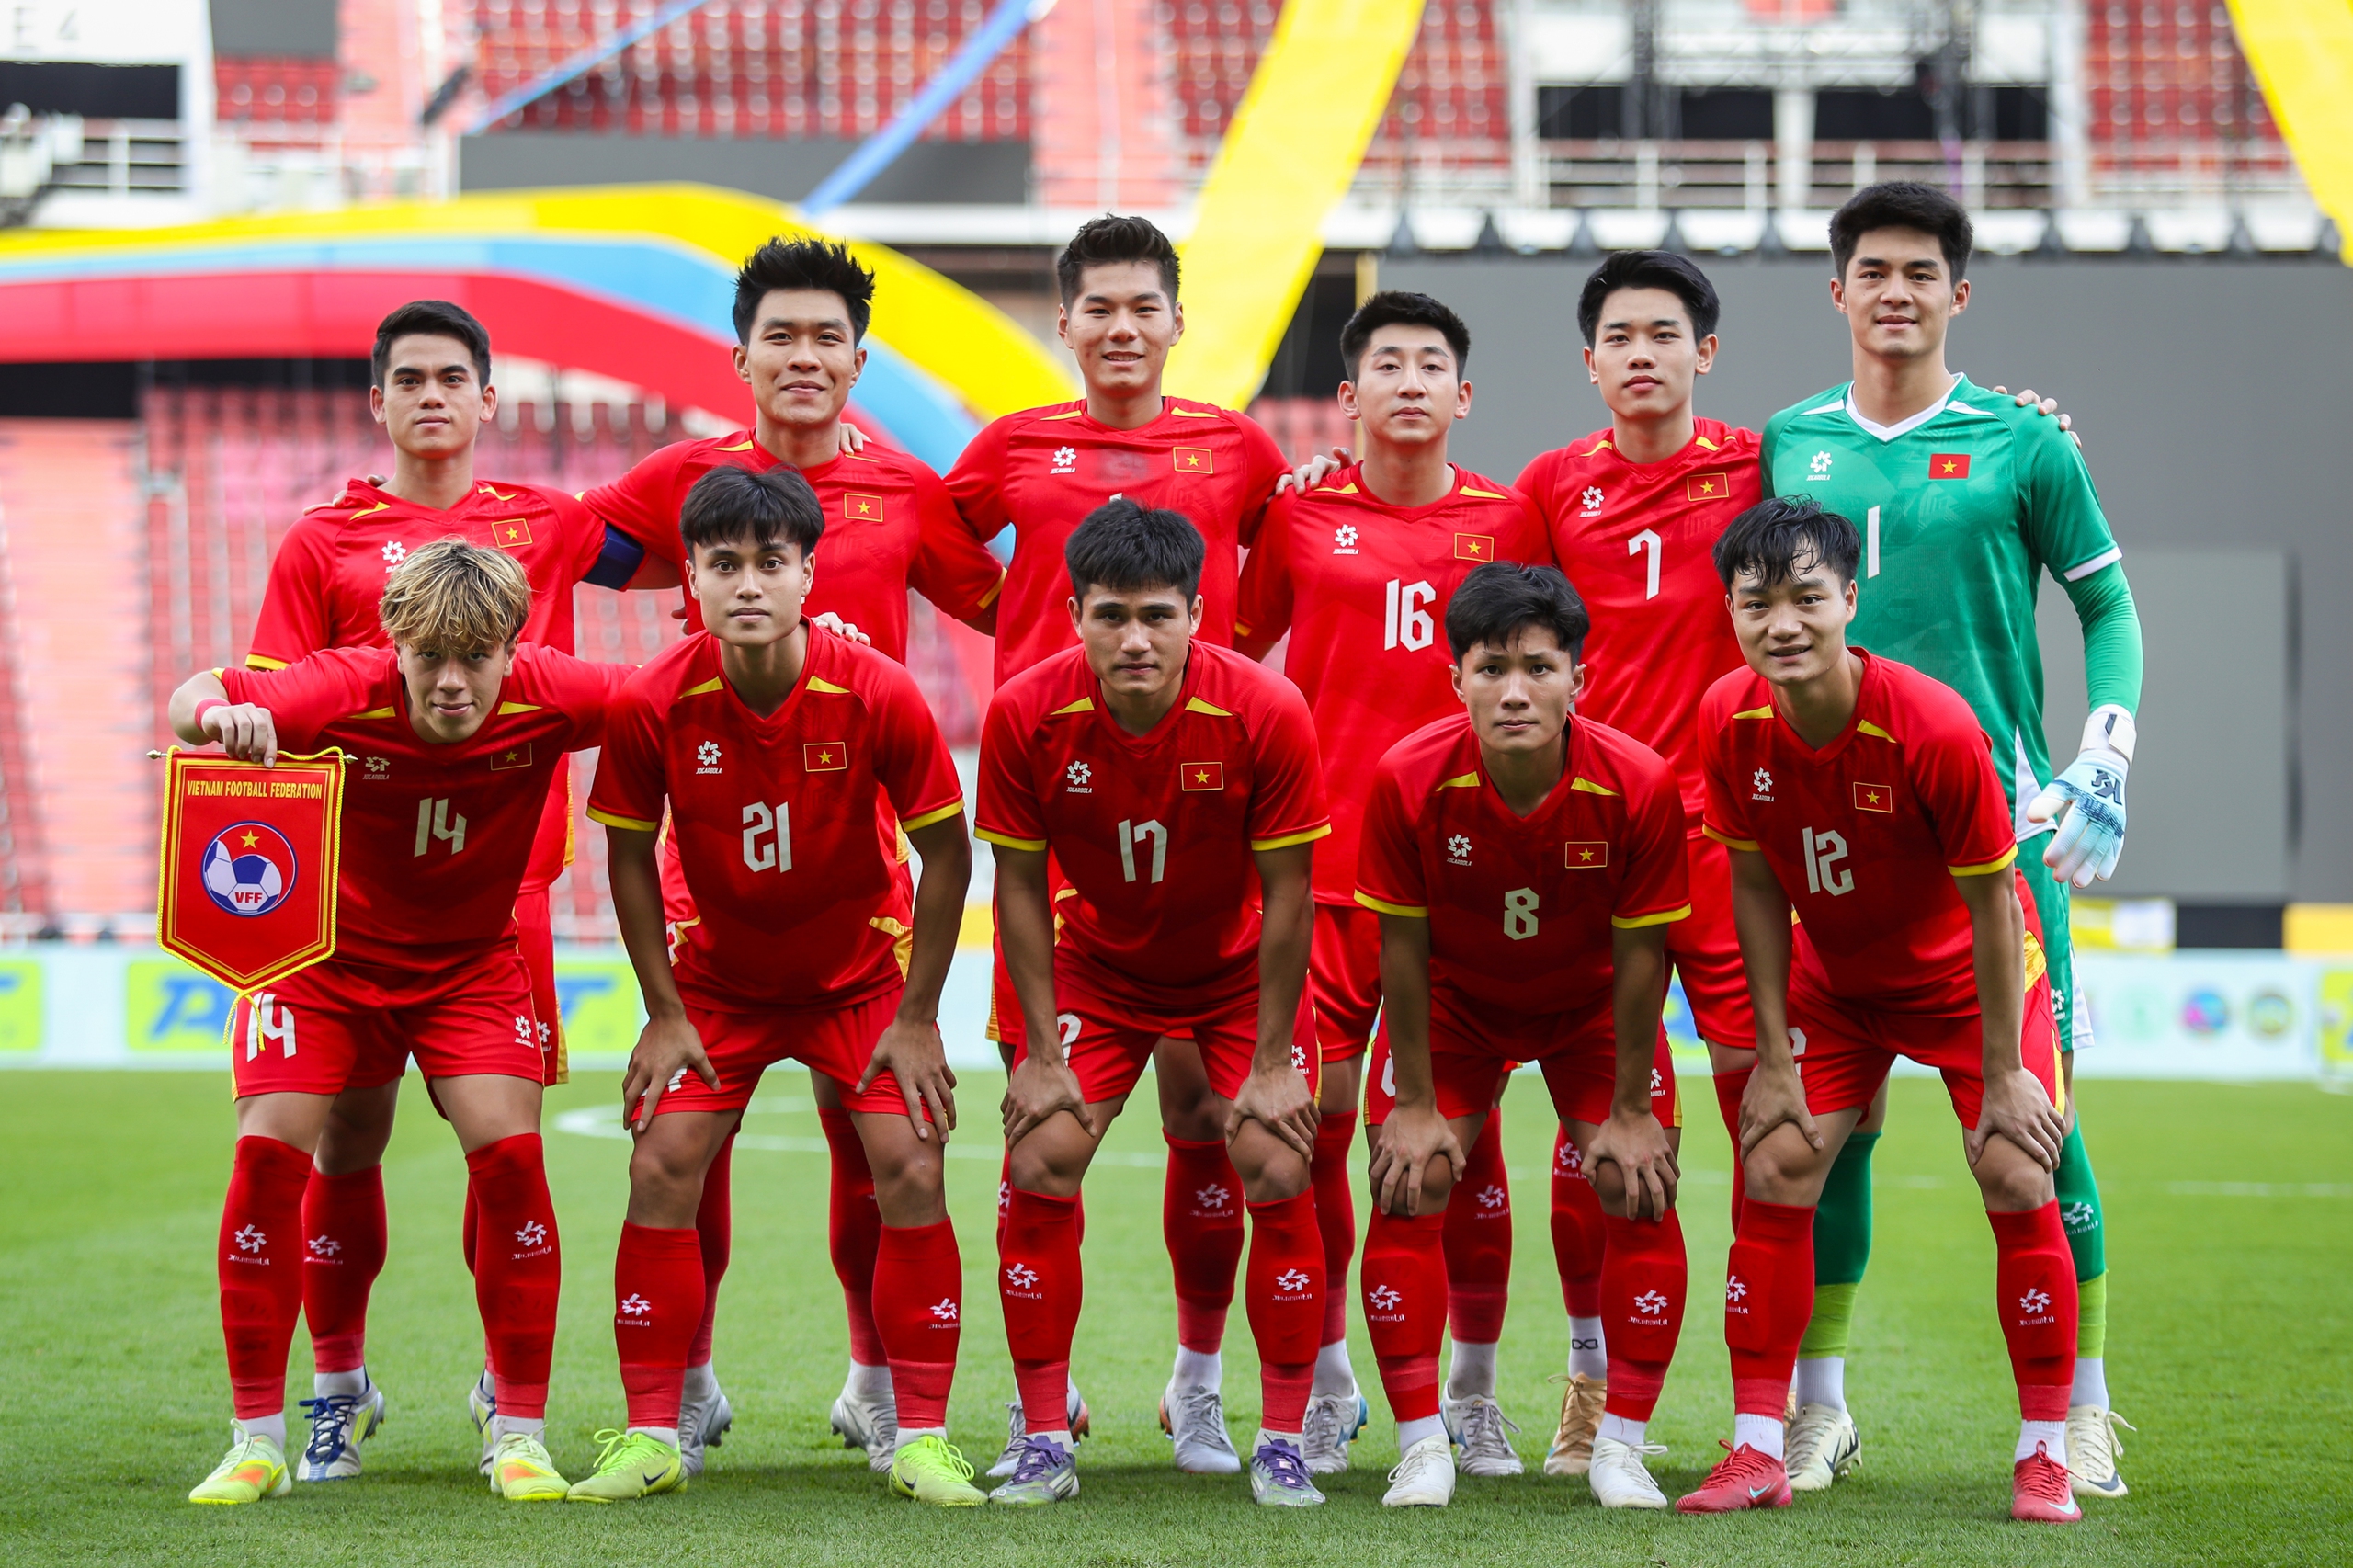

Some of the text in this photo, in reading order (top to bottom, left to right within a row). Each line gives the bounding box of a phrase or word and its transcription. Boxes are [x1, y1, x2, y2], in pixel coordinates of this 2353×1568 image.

[1628, 528, 1662, 600] 7
[1867, 505, 1881, 579] 1
[1384, 578, 1436, 652] 16
[188, 780, 322, 799] VIETNAM FOOTBALL FEDERATION
[414, 797, 467, 858] 14
[743, 801, 792, 873] 21
[1118, 819, 1167, 883] 17
[1802, 826, 1855, 896] 12
[235, 892, 263, 903] VFF
[1504, 887, 1539, 940] 8
[246, 991, 297, 1062] 14
